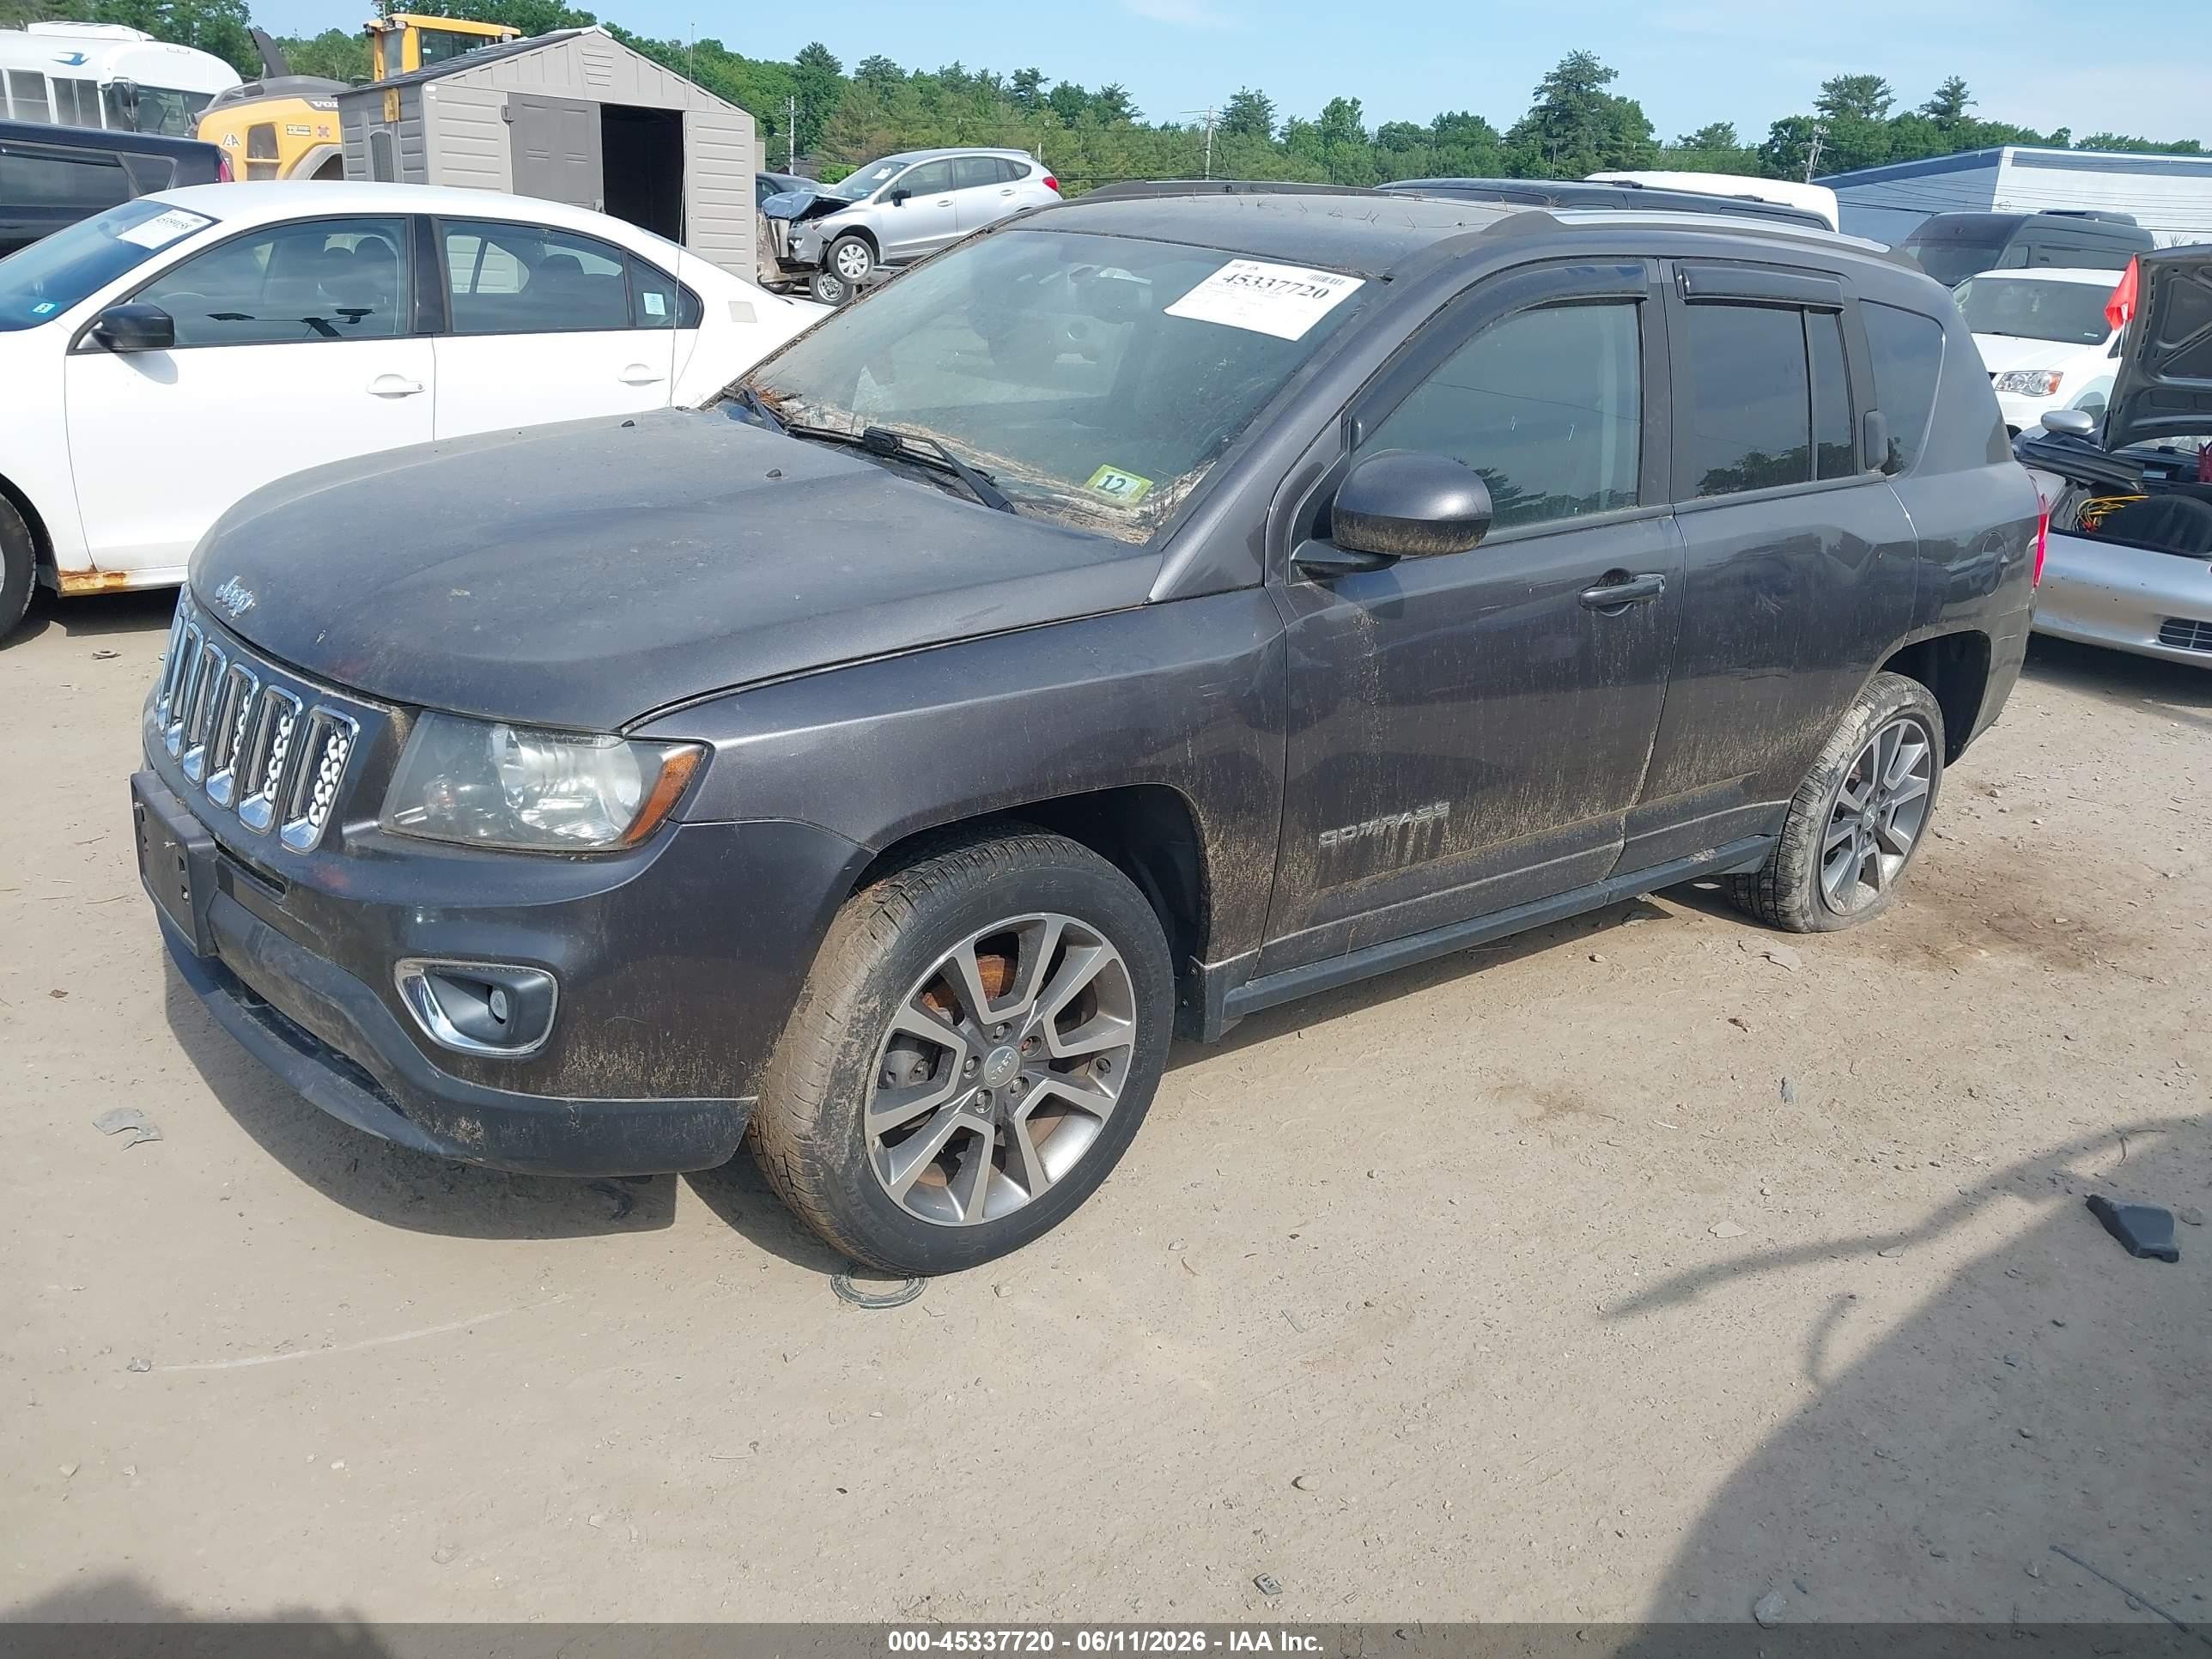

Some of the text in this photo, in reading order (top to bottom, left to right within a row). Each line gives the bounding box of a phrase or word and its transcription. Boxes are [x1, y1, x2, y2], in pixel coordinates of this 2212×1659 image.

[1222, 272, 1330, 300] 45337720
[1096, 474, 1127, 495] 12
[215, 574, 256, 621] Jeep
[1318, 801, 1450, 848] COMPASS
